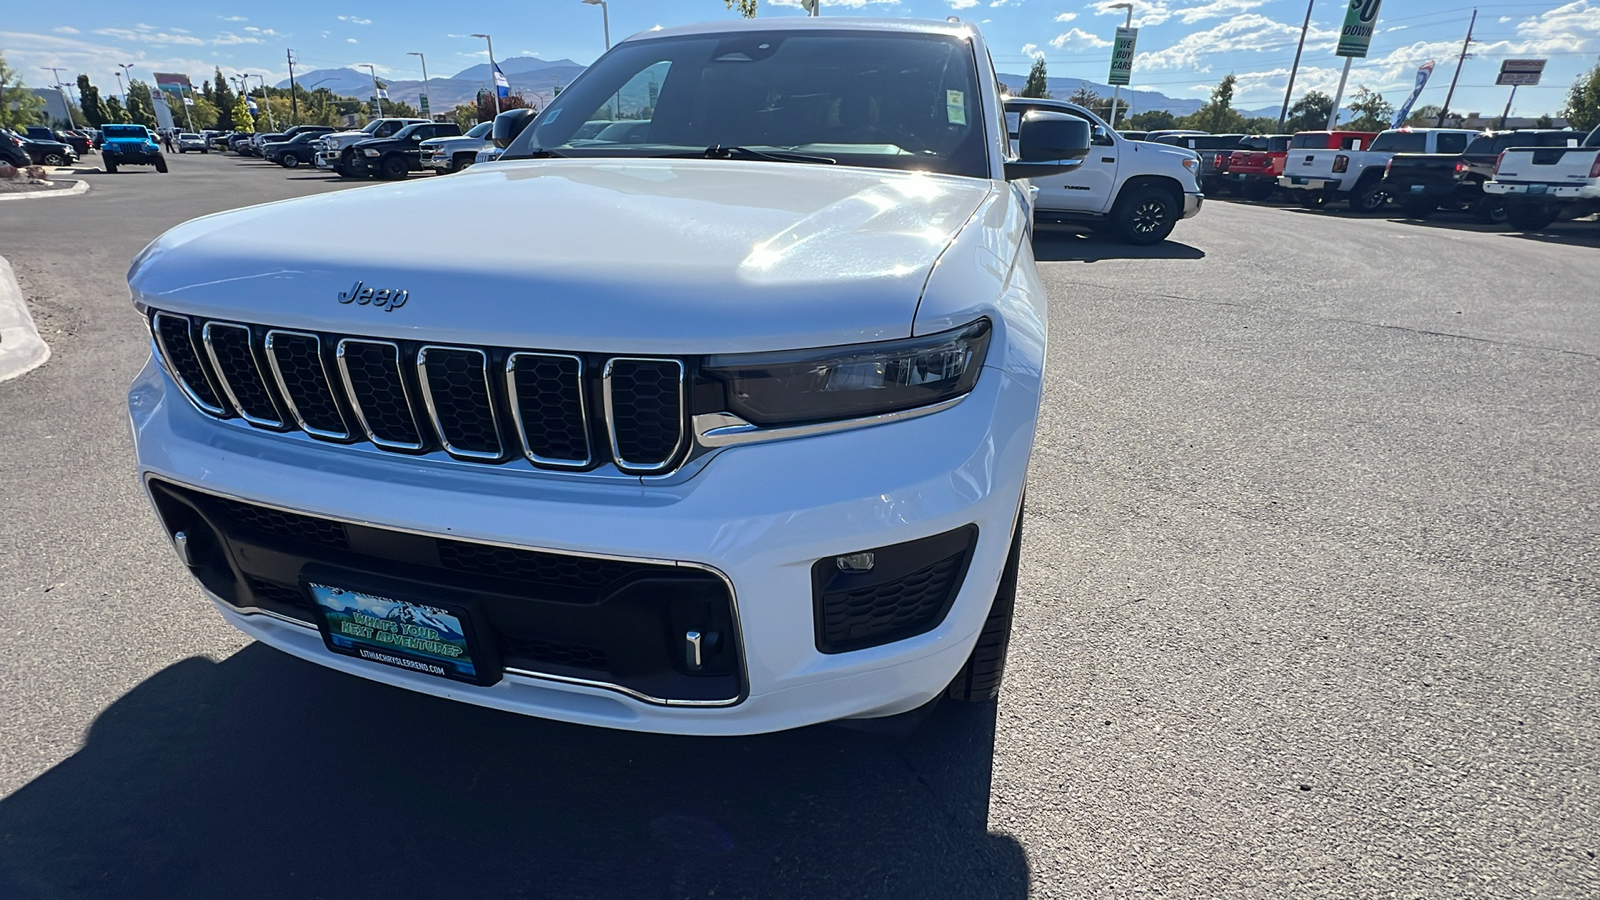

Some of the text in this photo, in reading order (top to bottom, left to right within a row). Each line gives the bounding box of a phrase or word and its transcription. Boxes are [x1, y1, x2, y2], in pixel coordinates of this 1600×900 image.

[1342, 25, 1374, 37] DOWN
[1120, 40, 1132, 49] WE
[1116, 50, 1133, 59] BUY
[1111, 61, 1132, 70] CARS
[338, 280, 409, 312] Jeep
[353, 610, 440, 641] WHAT'S YOUR
[341, 621, 463, 657] NEXT ADVENTURE?
